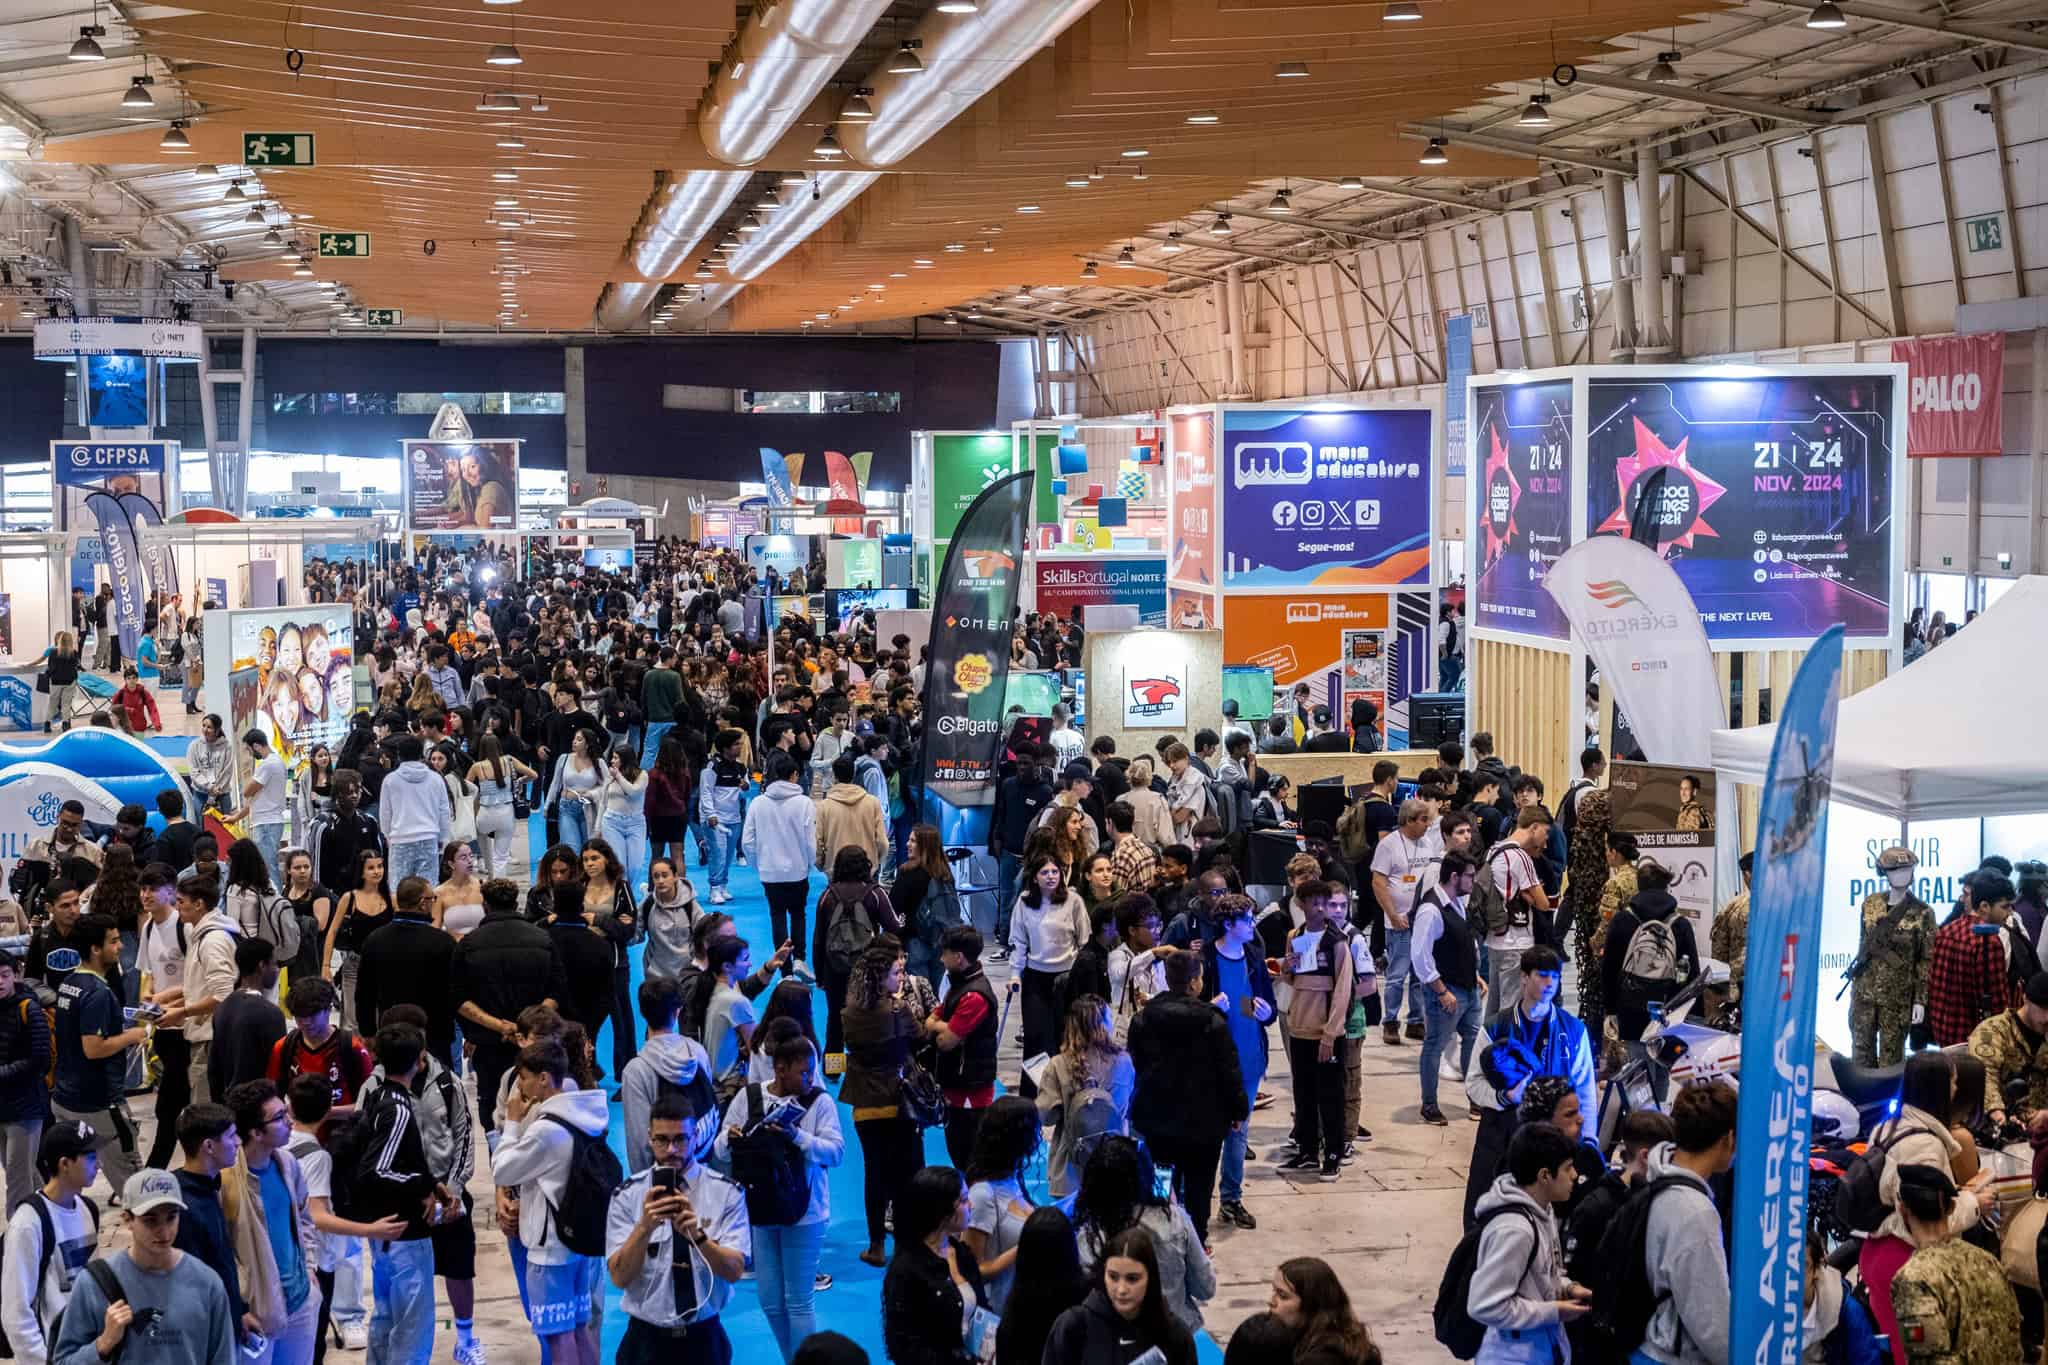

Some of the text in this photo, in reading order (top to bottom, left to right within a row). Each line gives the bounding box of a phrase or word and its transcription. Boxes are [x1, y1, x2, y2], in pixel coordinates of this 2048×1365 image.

[1911, 373, 1981, 412] PALCO
[96, 447, 149, 465] CFPSA
[1530, 444, 1562, 471] 21 24
[1753, 441, 1843, 469] 21 24
[1753, 474, 1843, 492] NOV. 2024
[1297, 541, 1355, 554] Segue-nos!
[1131, 573, 1161, 582] NORTE
[1700, 611, 1774, 622] THE NEXT LEVEL
[1656, 834, 1667, 845] DE
[1666, 832, 1700, 845] ADMISSÃO
[1759, 1018, 1796, 1307] AÉREA
